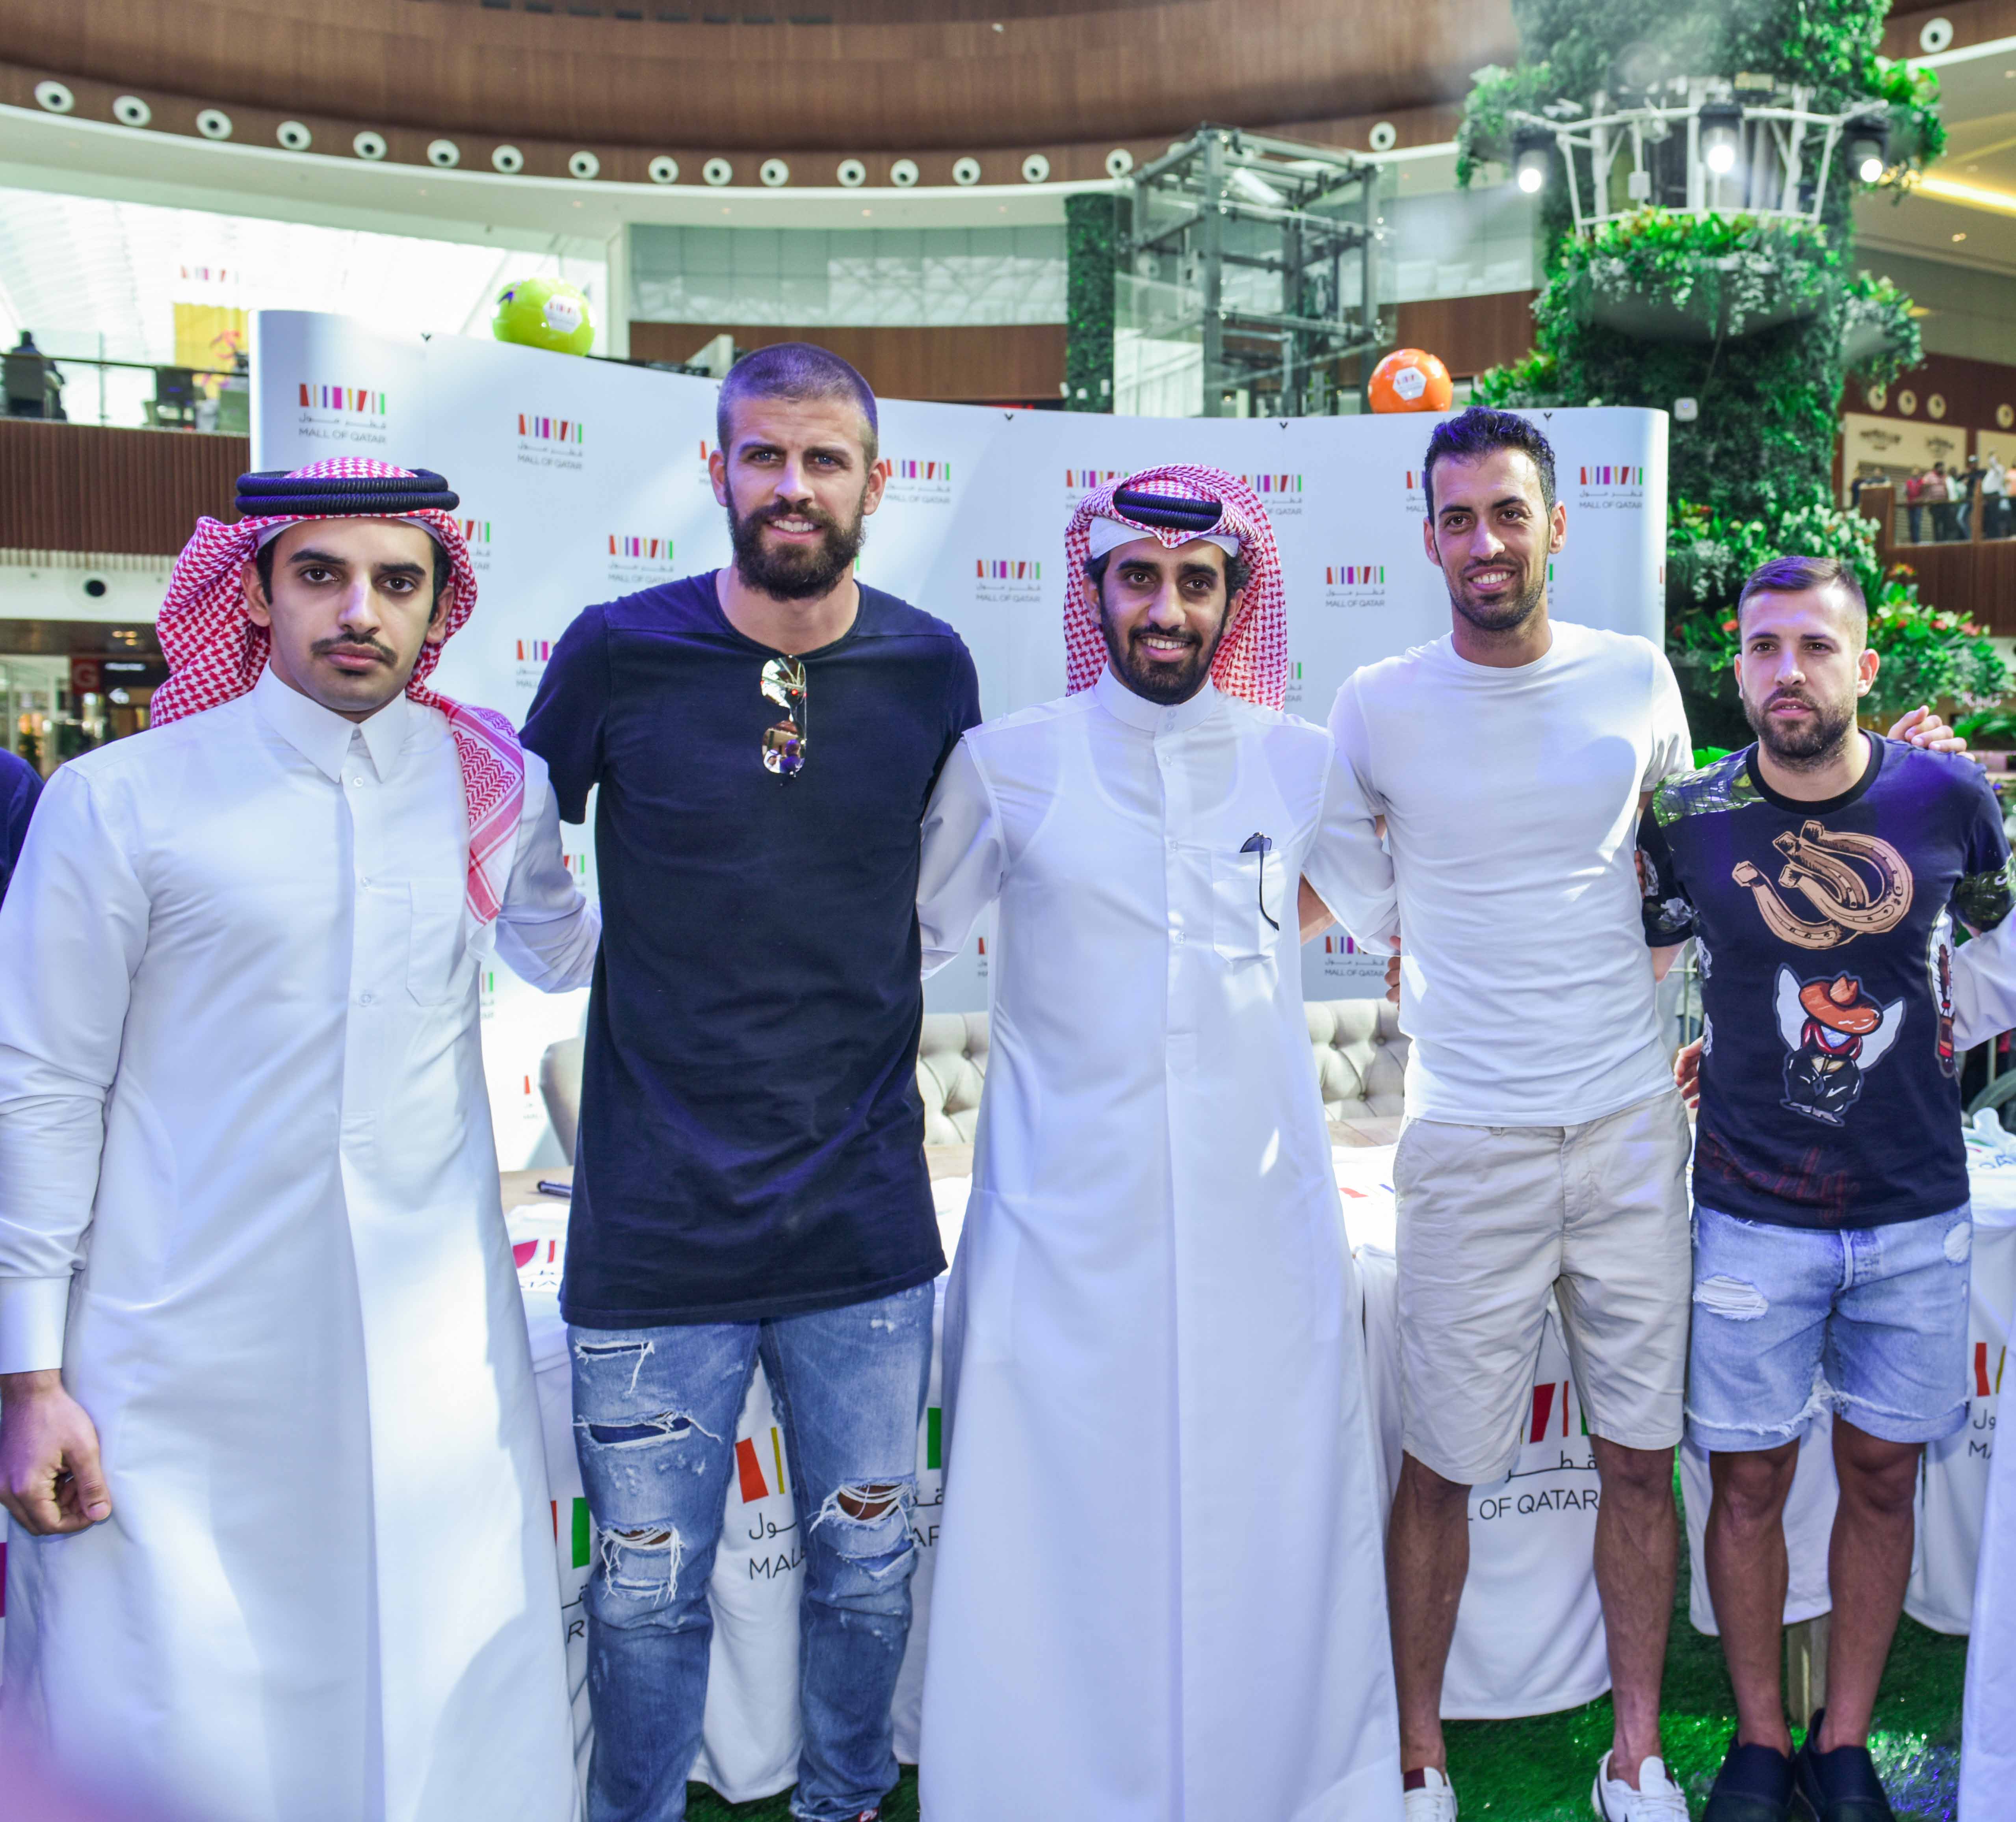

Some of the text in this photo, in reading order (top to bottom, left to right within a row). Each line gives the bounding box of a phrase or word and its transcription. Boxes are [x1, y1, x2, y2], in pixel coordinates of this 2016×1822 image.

[299, 428, 386, 444] MALL OF QATAR
[517, 454, 582, 470] MALL OF QATAR
[1013, 594, 1041, 603] QATAR
[1479, 1489, 1599, 1520] OF QATAR
[749, 1546, 806, 1580] MALL
